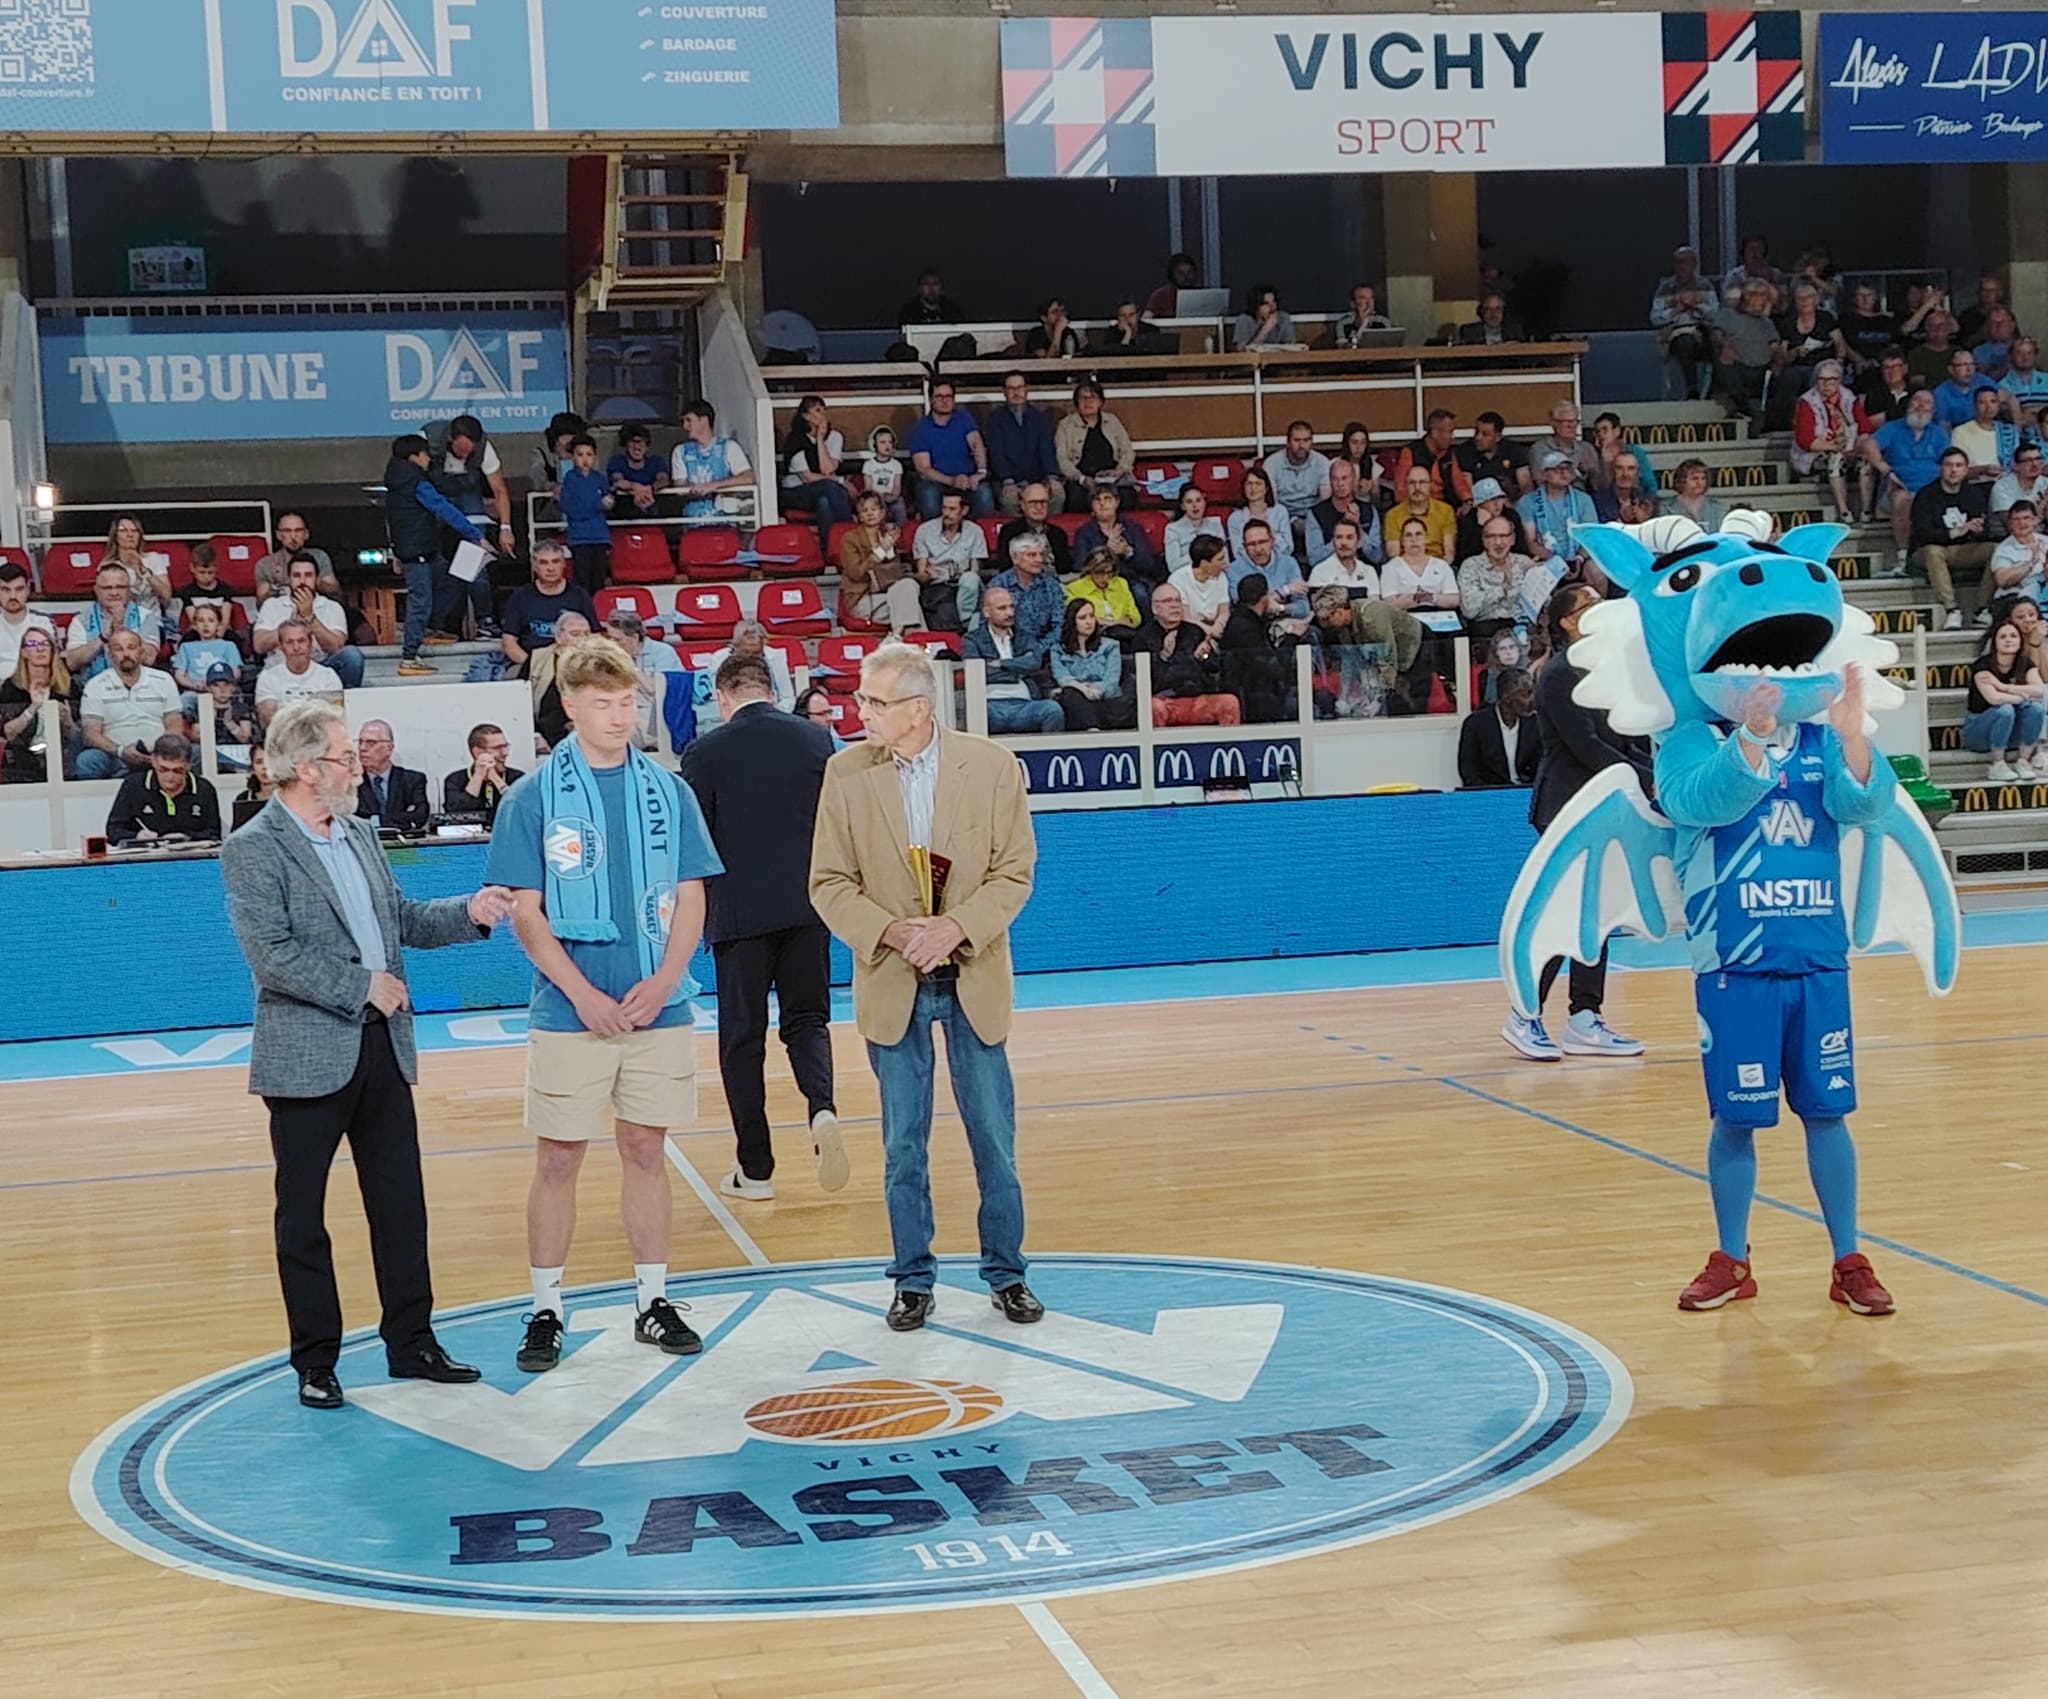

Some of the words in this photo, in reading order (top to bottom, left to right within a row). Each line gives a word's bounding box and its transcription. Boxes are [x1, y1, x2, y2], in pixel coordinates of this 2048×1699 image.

[660, 6, 769, 19] COUVERTURE
[662, 38, 738, 51] BARDAGE
[1274, 31, 1545, 90] VICHY
[663, 71, 750, 83] ZINGUERIE
[282, 87, 392, 101] CONFIANCE
[397, 86, 423, 100] EN
[428, 86, 471, 100] TOIT
[1337, 118, 1496, 155] SPORT
[68, 352, 328, 404] TRIBUNE
[481, 405, 500, 418] EN
[506, 405, 540, 418] TOIT
[812, 1443, 1001, 1472] VICHY
[450, 1423, 1397, 1565] BASKET
[903, 1530, 1073, 1572] 1914
